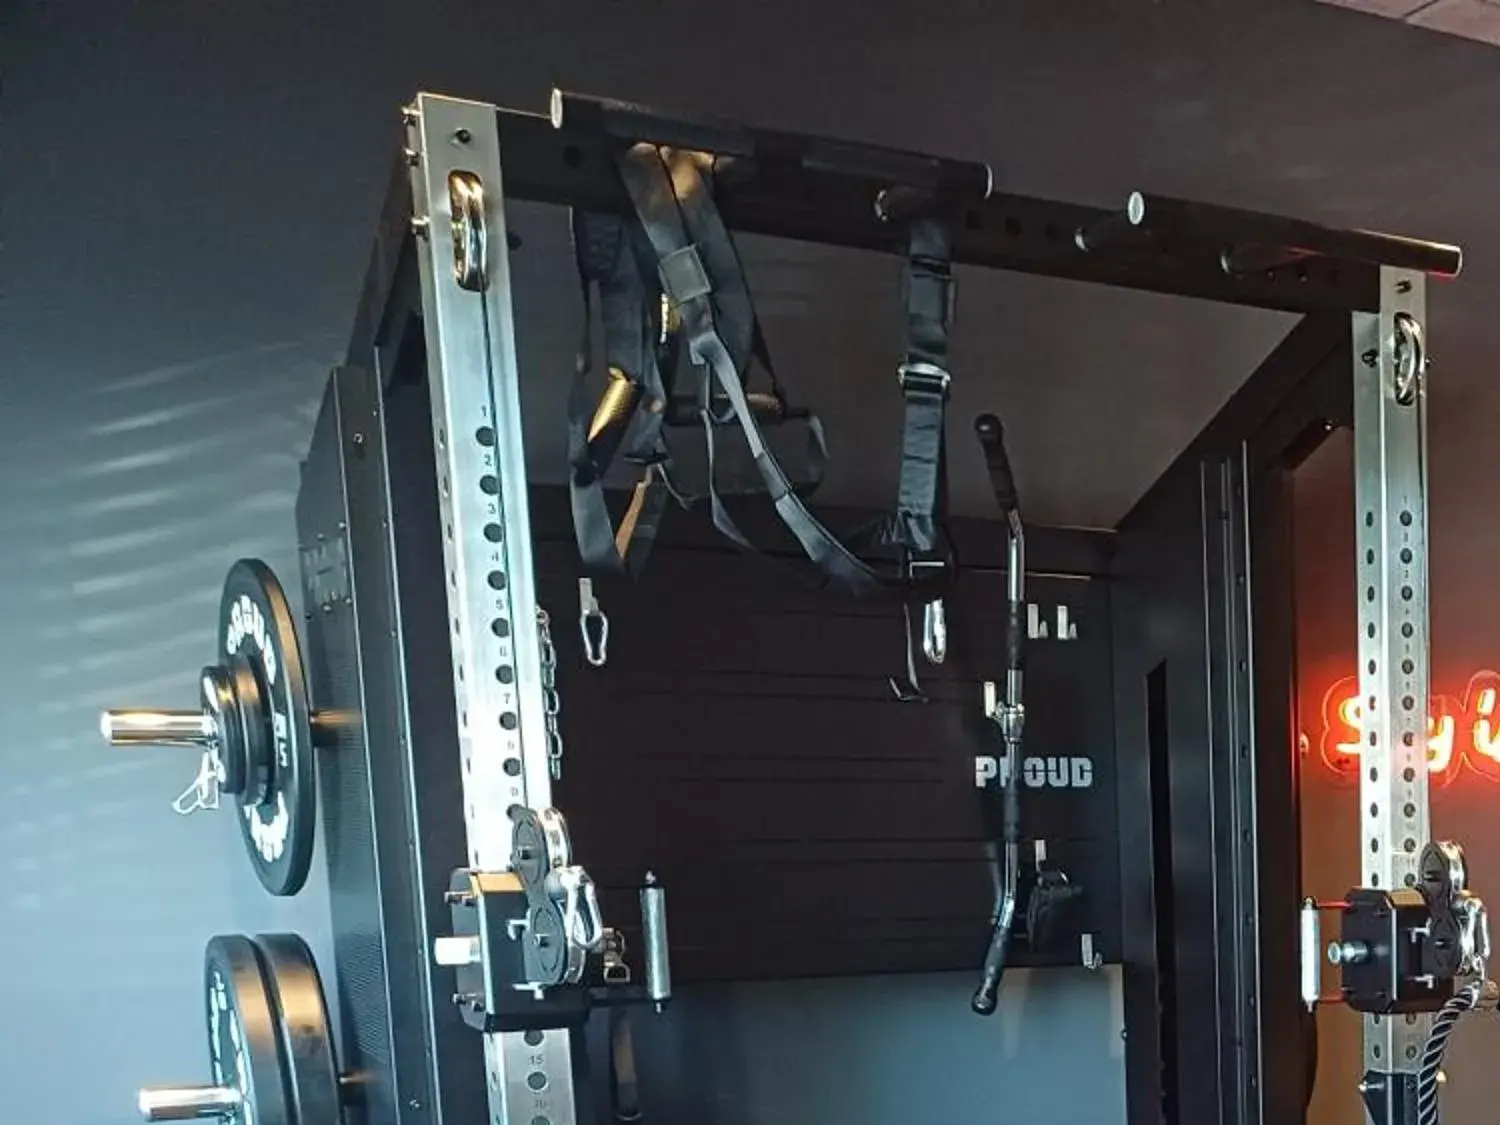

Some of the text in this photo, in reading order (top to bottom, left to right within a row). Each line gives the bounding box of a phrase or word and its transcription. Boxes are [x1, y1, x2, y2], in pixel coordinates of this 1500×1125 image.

[484, 454, 492, 466] 2
[487, 503, 497, 514] 3
[1336, 696, 1454, 772] Sy
